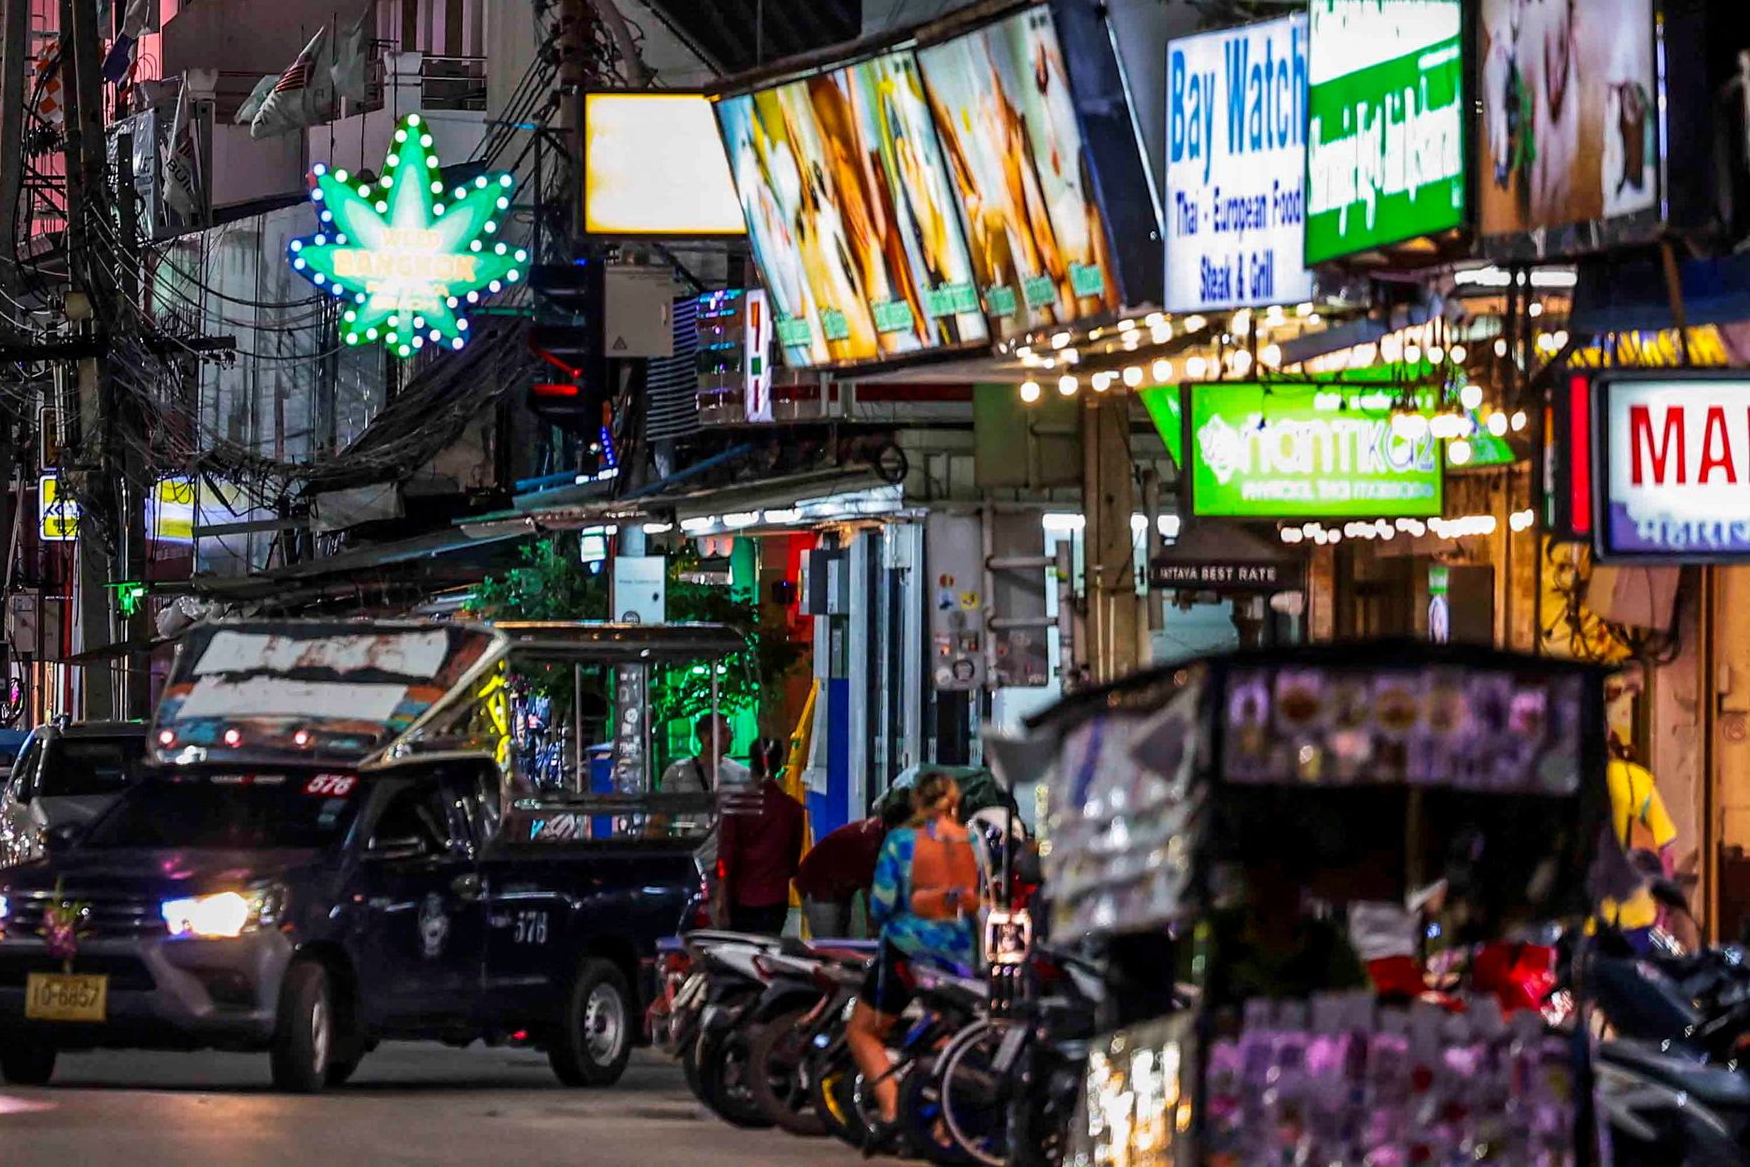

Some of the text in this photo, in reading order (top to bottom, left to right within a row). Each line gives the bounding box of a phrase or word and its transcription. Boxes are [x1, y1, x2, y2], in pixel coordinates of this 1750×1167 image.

[1170, 50, 1215, 186] Bay
[1225, 26, 1307, 156] Watch
[1176, 190, 1199, 238] Thai
[1214, 187, 1267, 242] European
[1272, 180, 1301, 228] Food
[1200, 249, 1274, 303] Steak & Grill
[1629, 404, 1750, 486] MA
[1201, 566, 1233, 582] BEST
[1238, 566, 1276, 583] RATE
